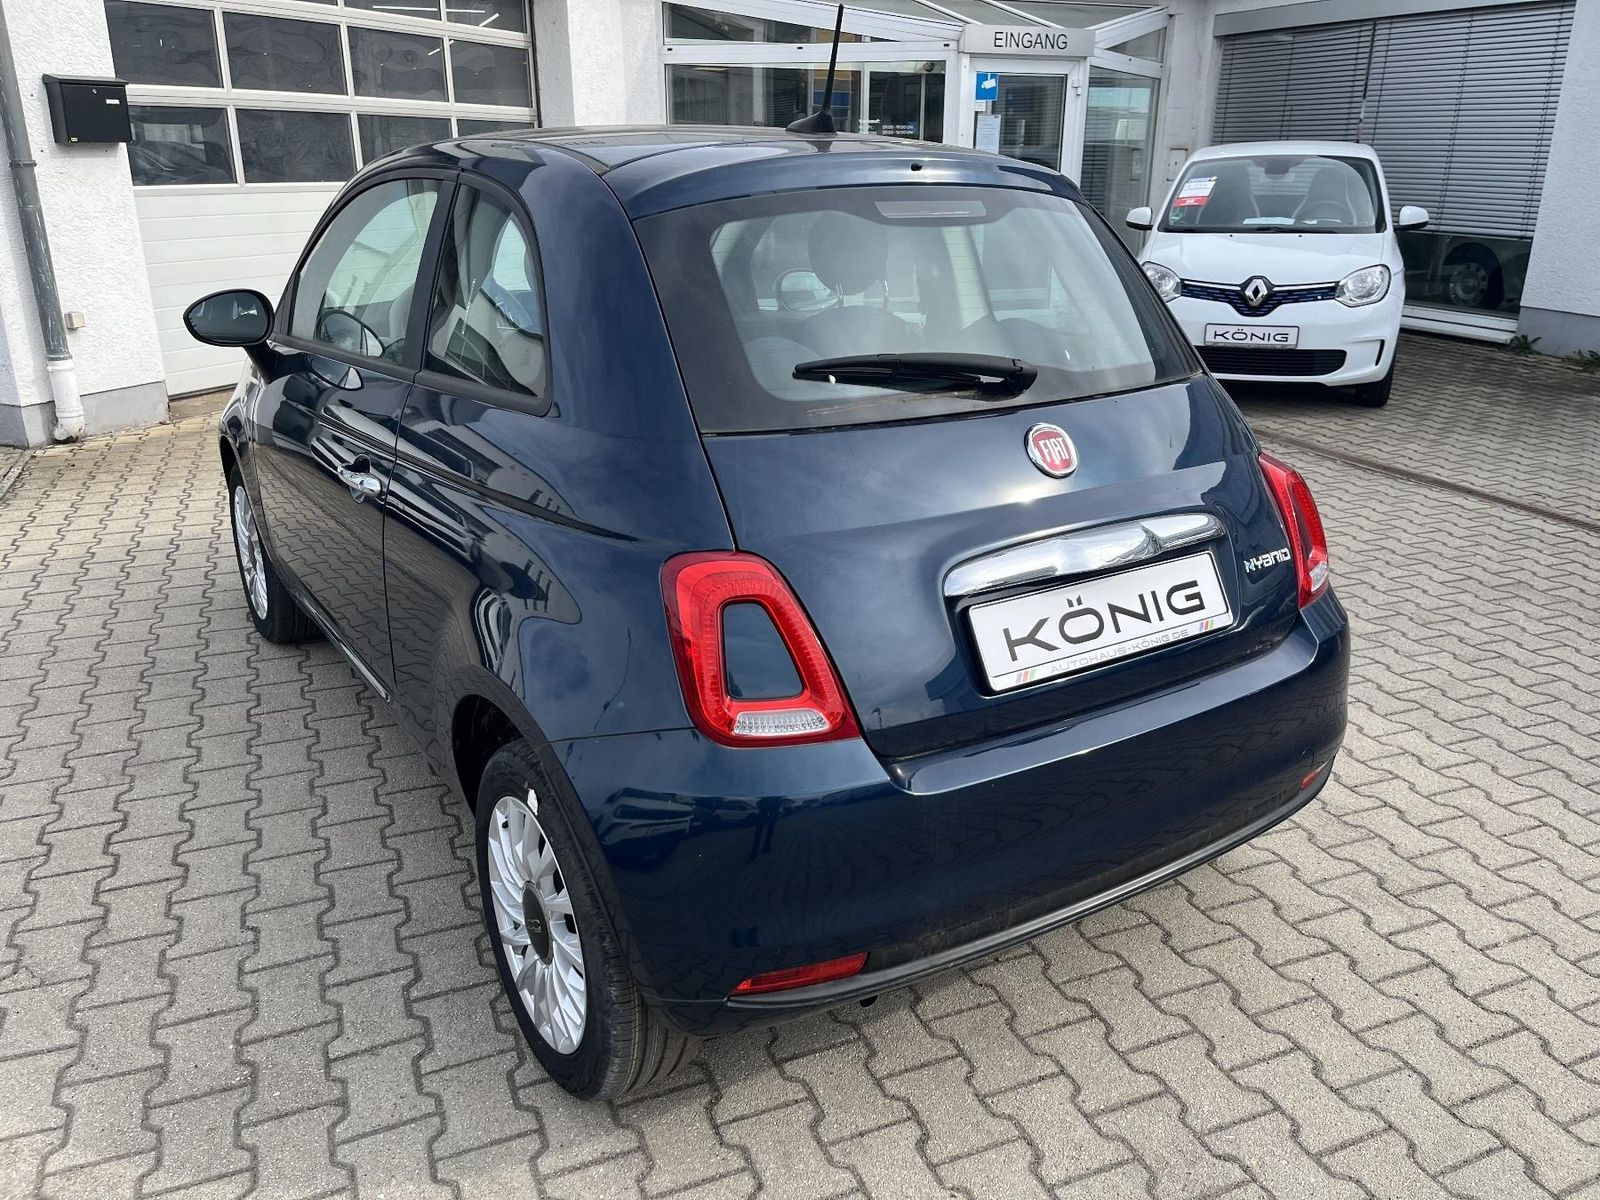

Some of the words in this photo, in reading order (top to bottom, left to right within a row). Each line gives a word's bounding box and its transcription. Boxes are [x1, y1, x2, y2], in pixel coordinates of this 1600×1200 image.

[994, 31, 1068, 50] EINGANG
[1213, 328, 1289, 343] KÖNIG
[1037, 436, 1070, 465] FIAT
[1243, 547, 1291, 573] HYBRID
[1002, 579, 1206, 662] KÖNIG
